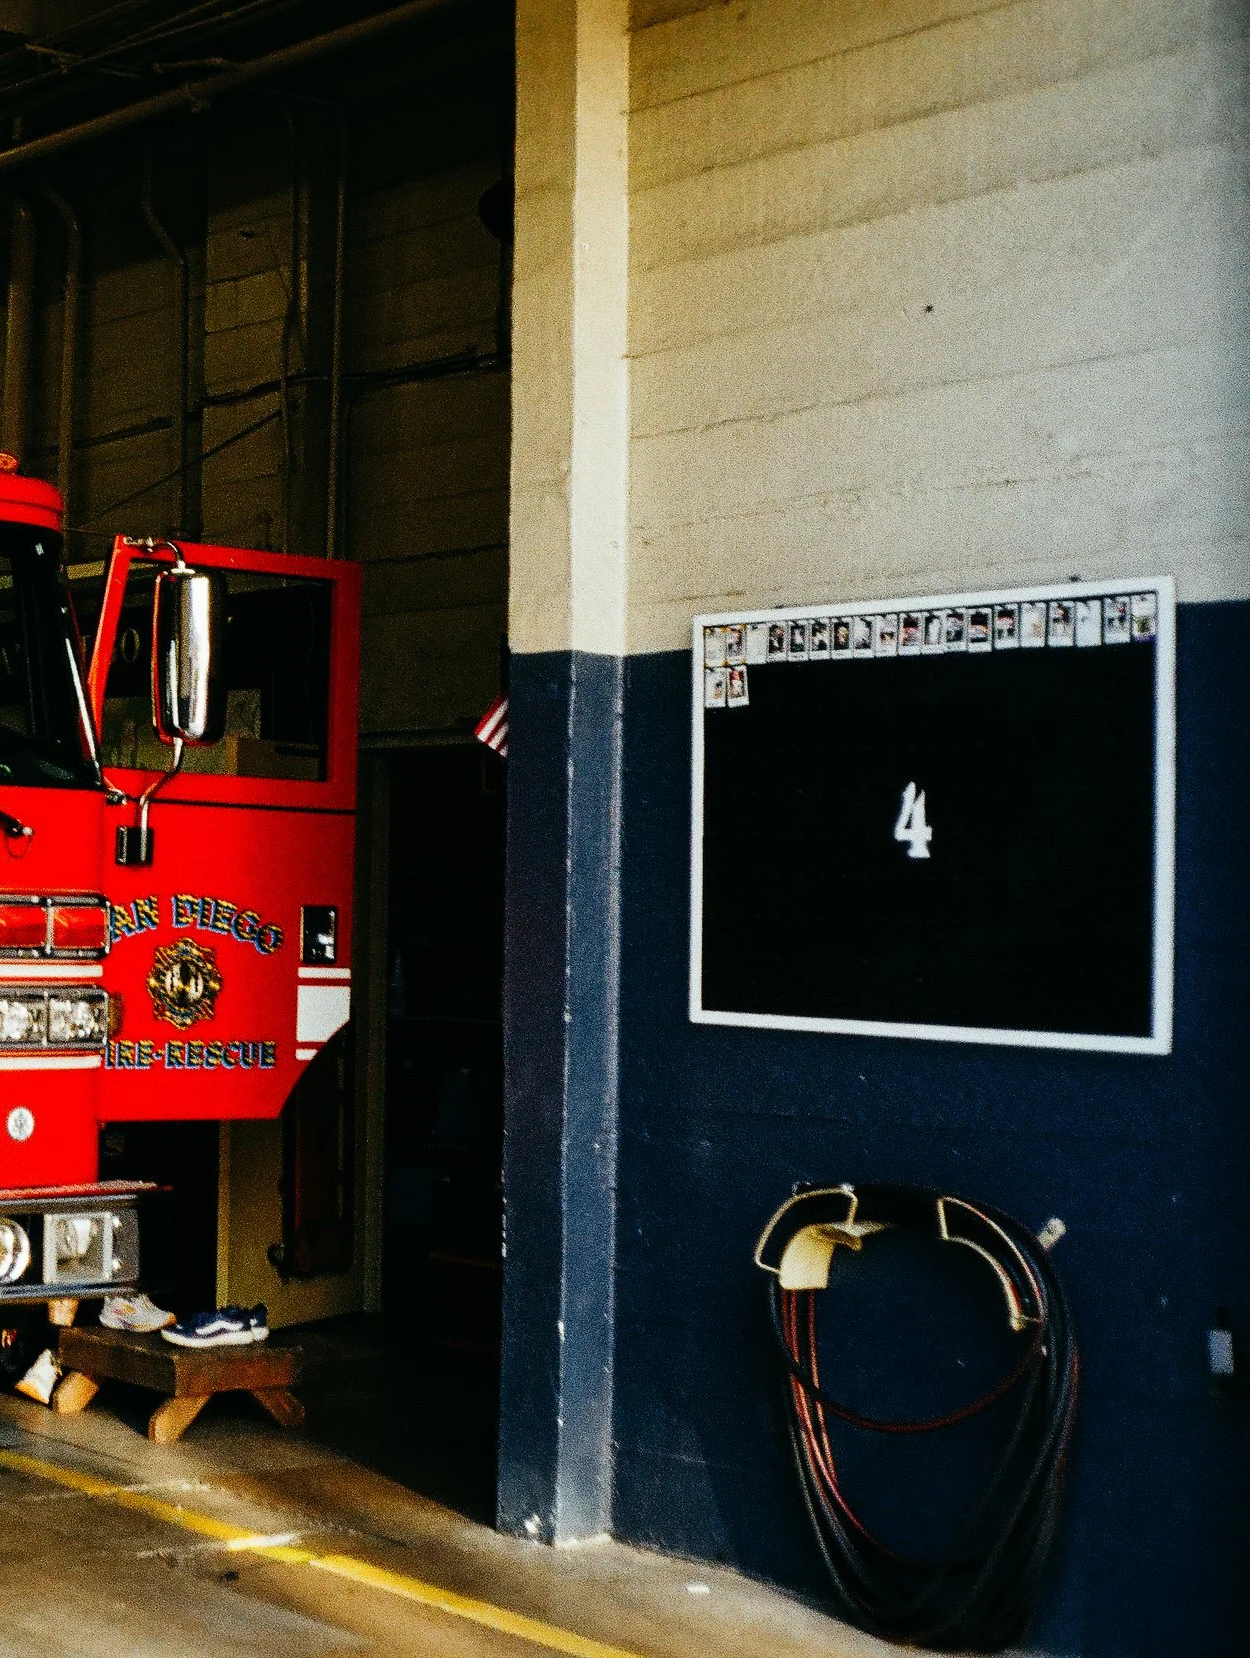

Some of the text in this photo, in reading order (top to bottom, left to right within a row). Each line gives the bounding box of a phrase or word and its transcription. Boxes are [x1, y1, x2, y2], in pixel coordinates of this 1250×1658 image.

[893, 781, 933, 858] 4
[110, 893, 284, 954] AN DIEGO
[100, 1039, 276, 1070] IRE-RESCUE
